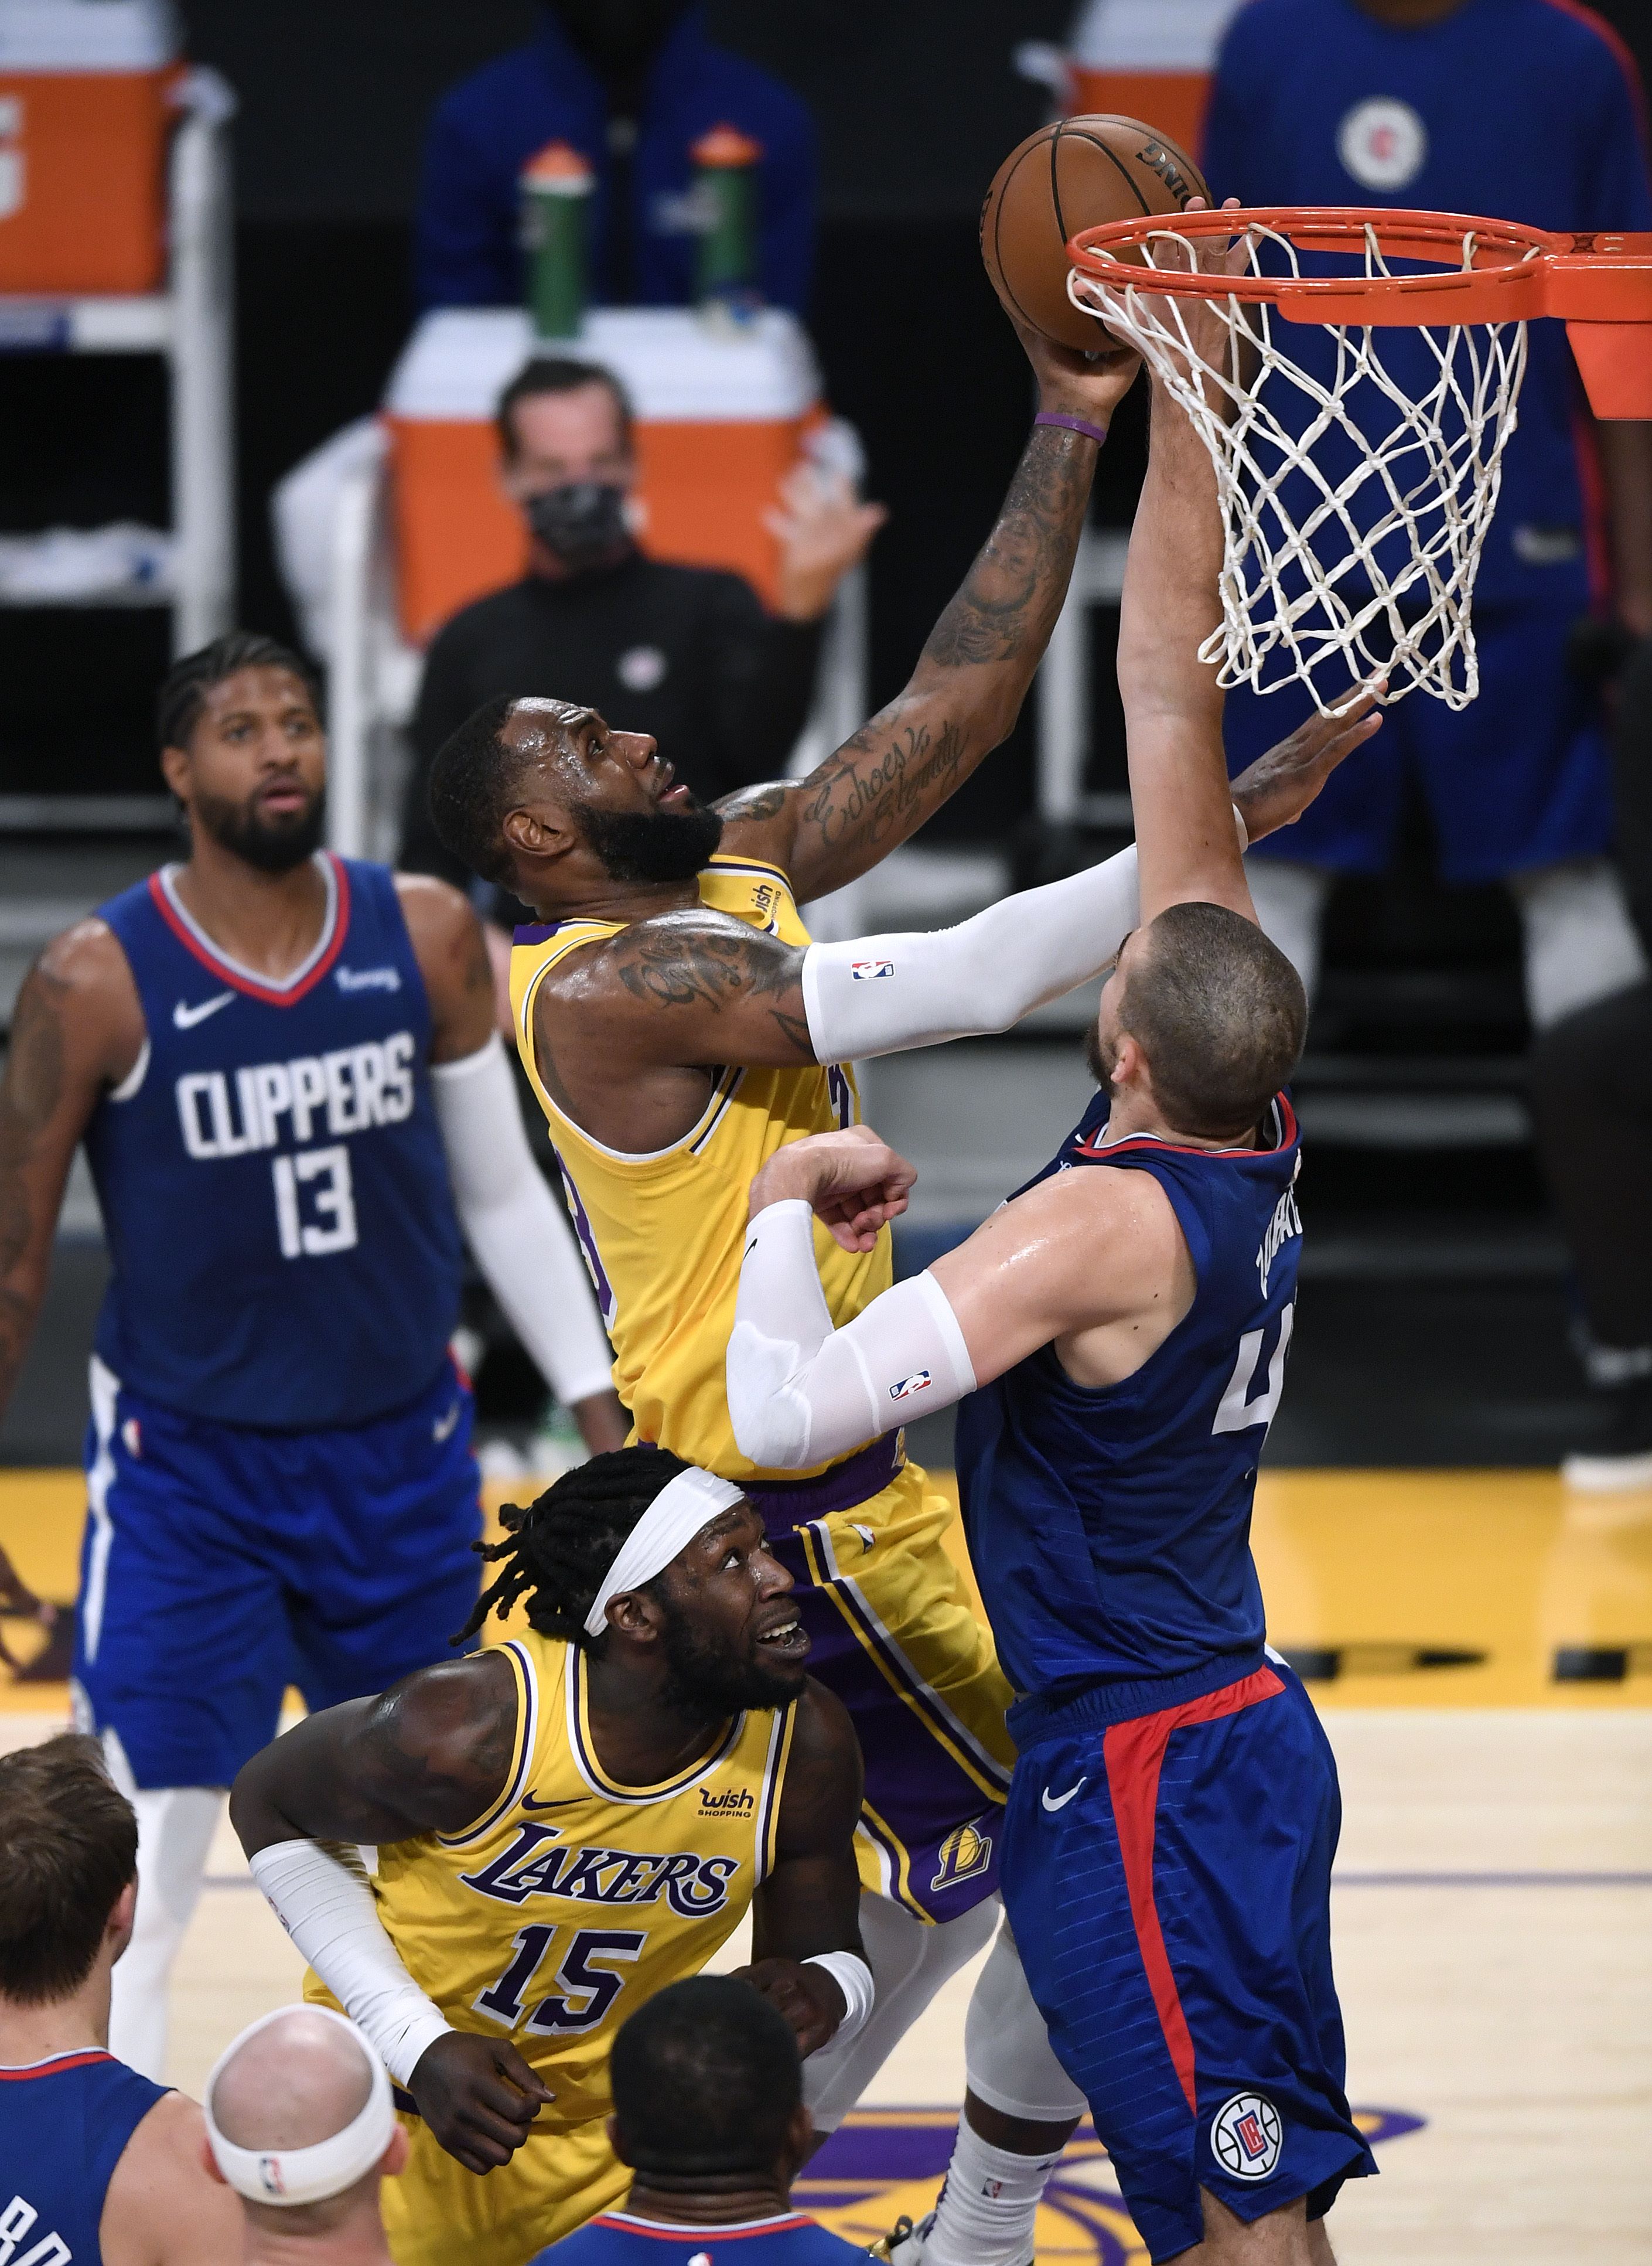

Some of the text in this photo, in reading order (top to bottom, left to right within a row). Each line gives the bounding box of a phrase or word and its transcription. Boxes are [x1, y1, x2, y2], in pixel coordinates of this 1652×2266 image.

[770, 890, 781, 919] HOPPING
[176, 1029, 415, 1160] CLIPPERS
[272, 1144, 359, 1259] 13
[697, 1810, 752, 1818] SHOPPING
[699, 1787, 755, 1810] wish
[458, 1821, 741, 1919] LAKERS
[471, 1923, 648, 2036] 15
